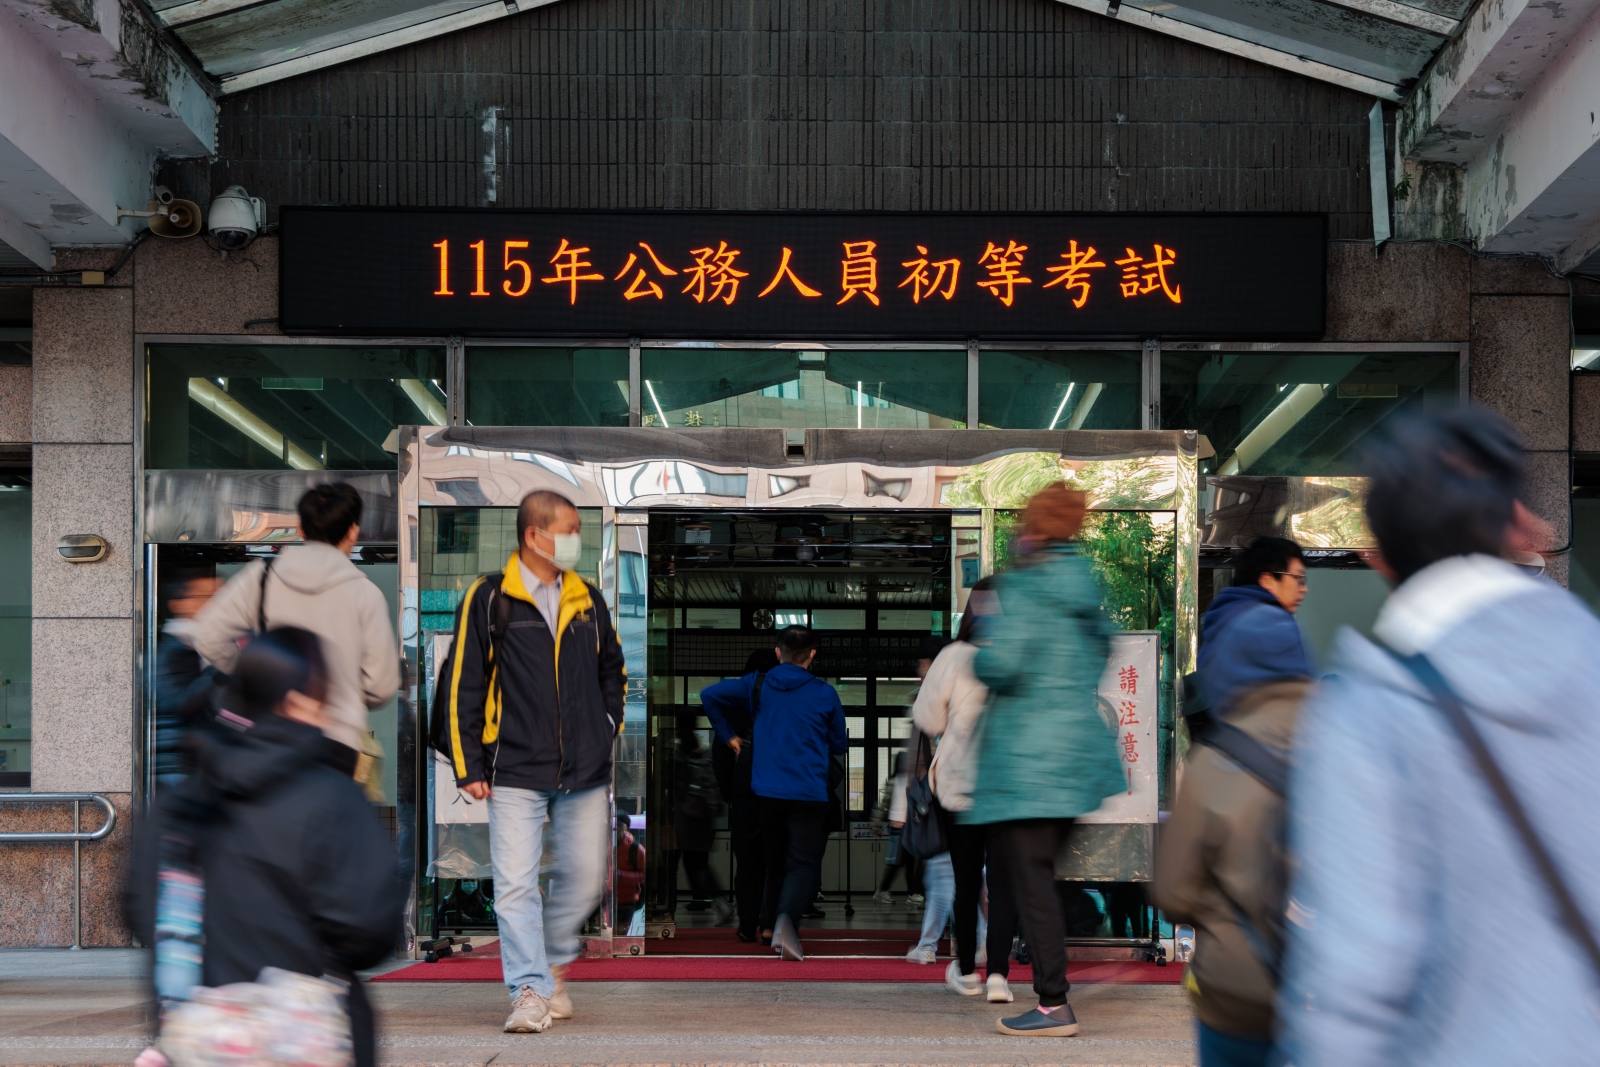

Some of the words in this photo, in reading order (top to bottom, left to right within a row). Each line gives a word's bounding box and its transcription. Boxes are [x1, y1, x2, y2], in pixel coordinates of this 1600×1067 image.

[431, 238, 1183, 309] 115年公務人員初等考試
